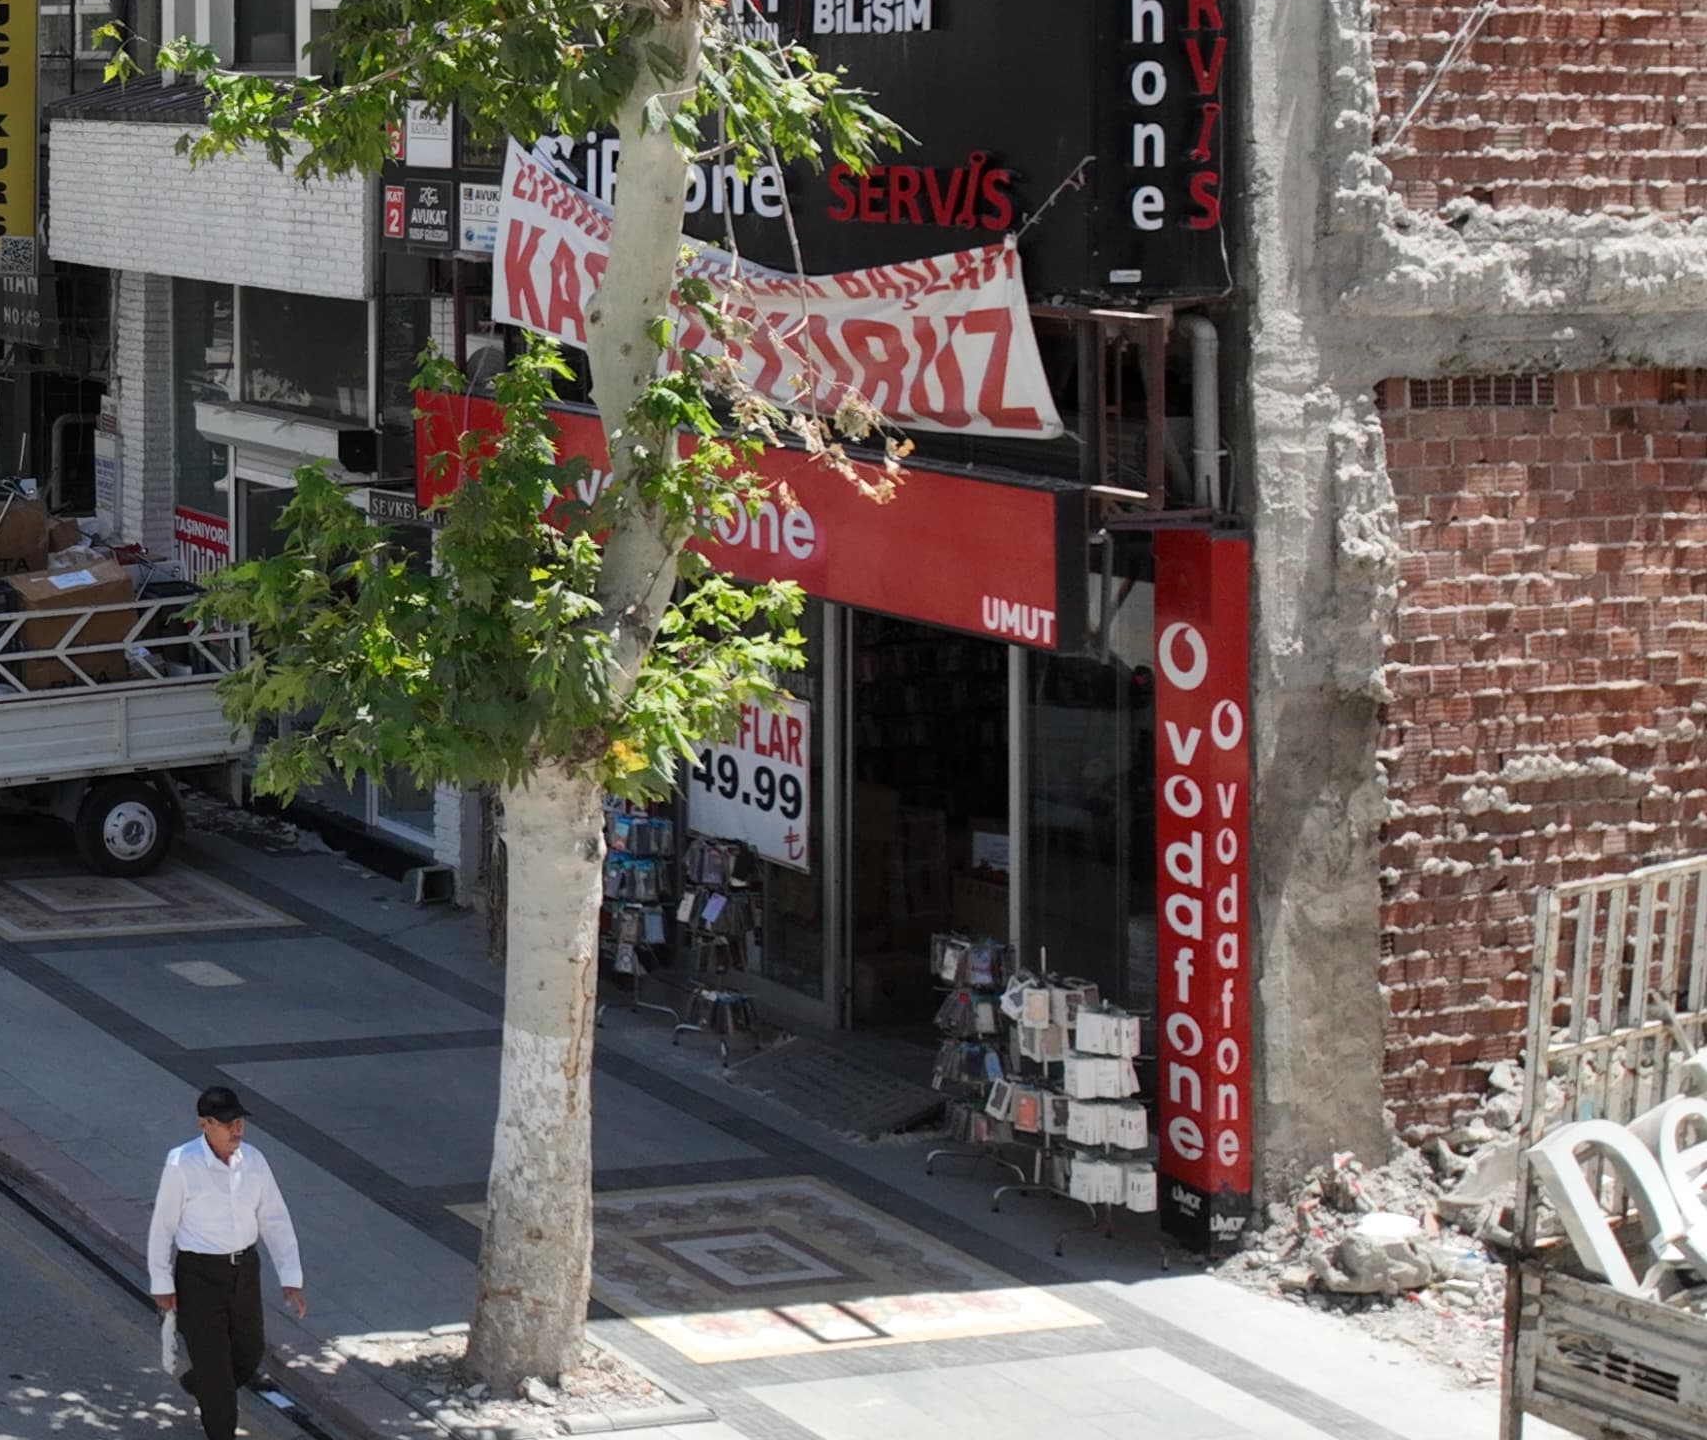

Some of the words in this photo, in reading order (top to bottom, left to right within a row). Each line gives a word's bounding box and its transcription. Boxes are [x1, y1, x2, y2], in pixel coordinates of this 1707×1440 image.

[386, 191, 404, 202] KAT
[389, 209, 400, 234] 2
[410, 209, 448, 225] AVUKAT
[982, 594, 1057, 644] UMUT
[692, 747, 803, 821] 49.99
[1163, 720, 1204, 1162] vodafone
[1214, 782, 1240, 1167] vodafone
